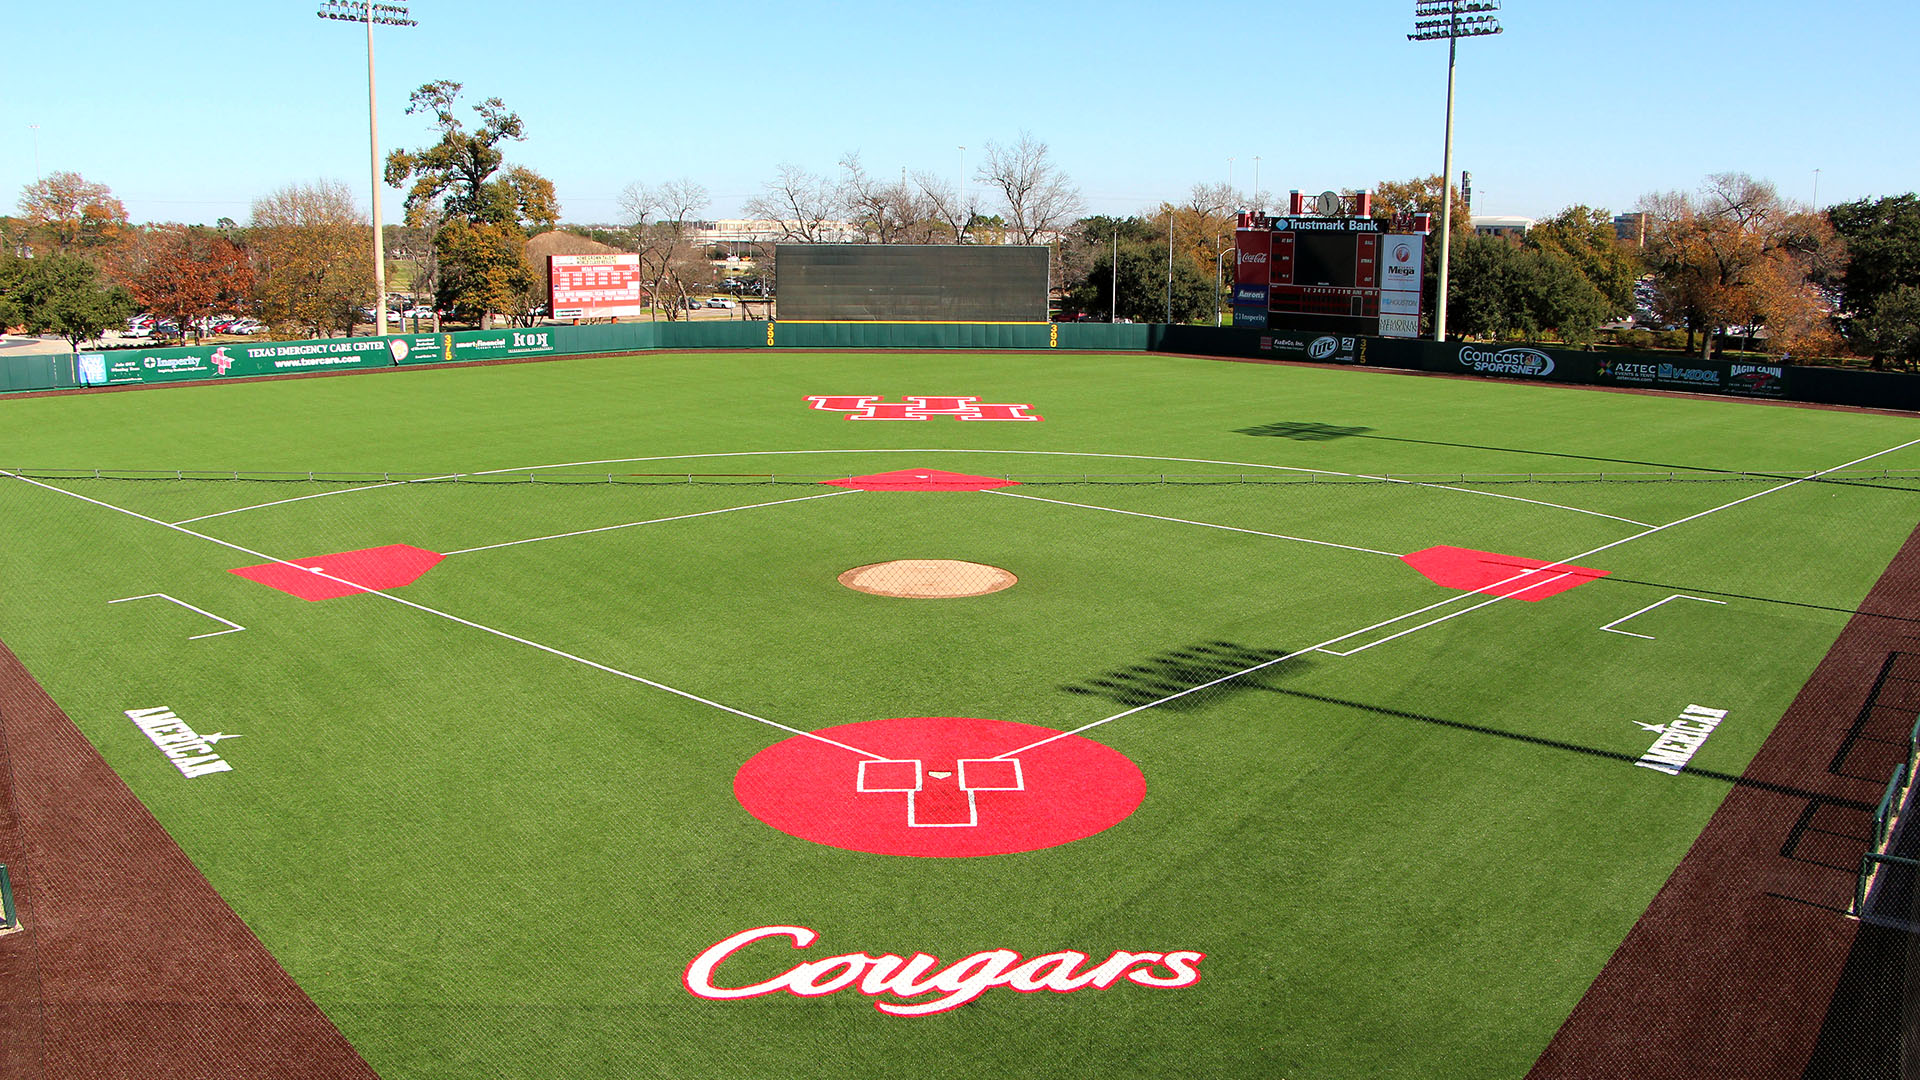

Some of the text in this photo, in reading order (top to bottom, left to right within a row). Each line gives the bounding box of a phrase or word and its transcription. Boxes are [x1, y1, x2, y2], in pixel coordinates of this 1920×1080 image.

[1289, 219, 1378, 231] Trustmark Bank
[1388, 266, 1415, 276] Mega
[1241, 313, 1265, 322] Insperity
[1380, 318, 1418, 328] MEMORIAL
[767, 322, 775, 346] 390
[1050, 324, 1058, 347] 390
[1380, 323, 1417, 333] HERMANN
[247, 341, 385, 358] TEXAS EMERGENCY CARE CENTER
[444, 334, 453, 361] 375
[1312, 341, 1335, 358] Lite
[156, 355, 201, 369] Insperity
[1473, 362, 1541, 375] SPORTSNET
[1615, 363, 1656, 374] AZTEC
[1673, 367, 1720, 382] V-KOOL
[1731, 364, 1782, 379] RAGIN CAJUN
[123, 705, 233, 779] AMERICAN
[1634, 703, 1728, 776] AMERICAN
[682, 925, 1206, 1018] Cougars
